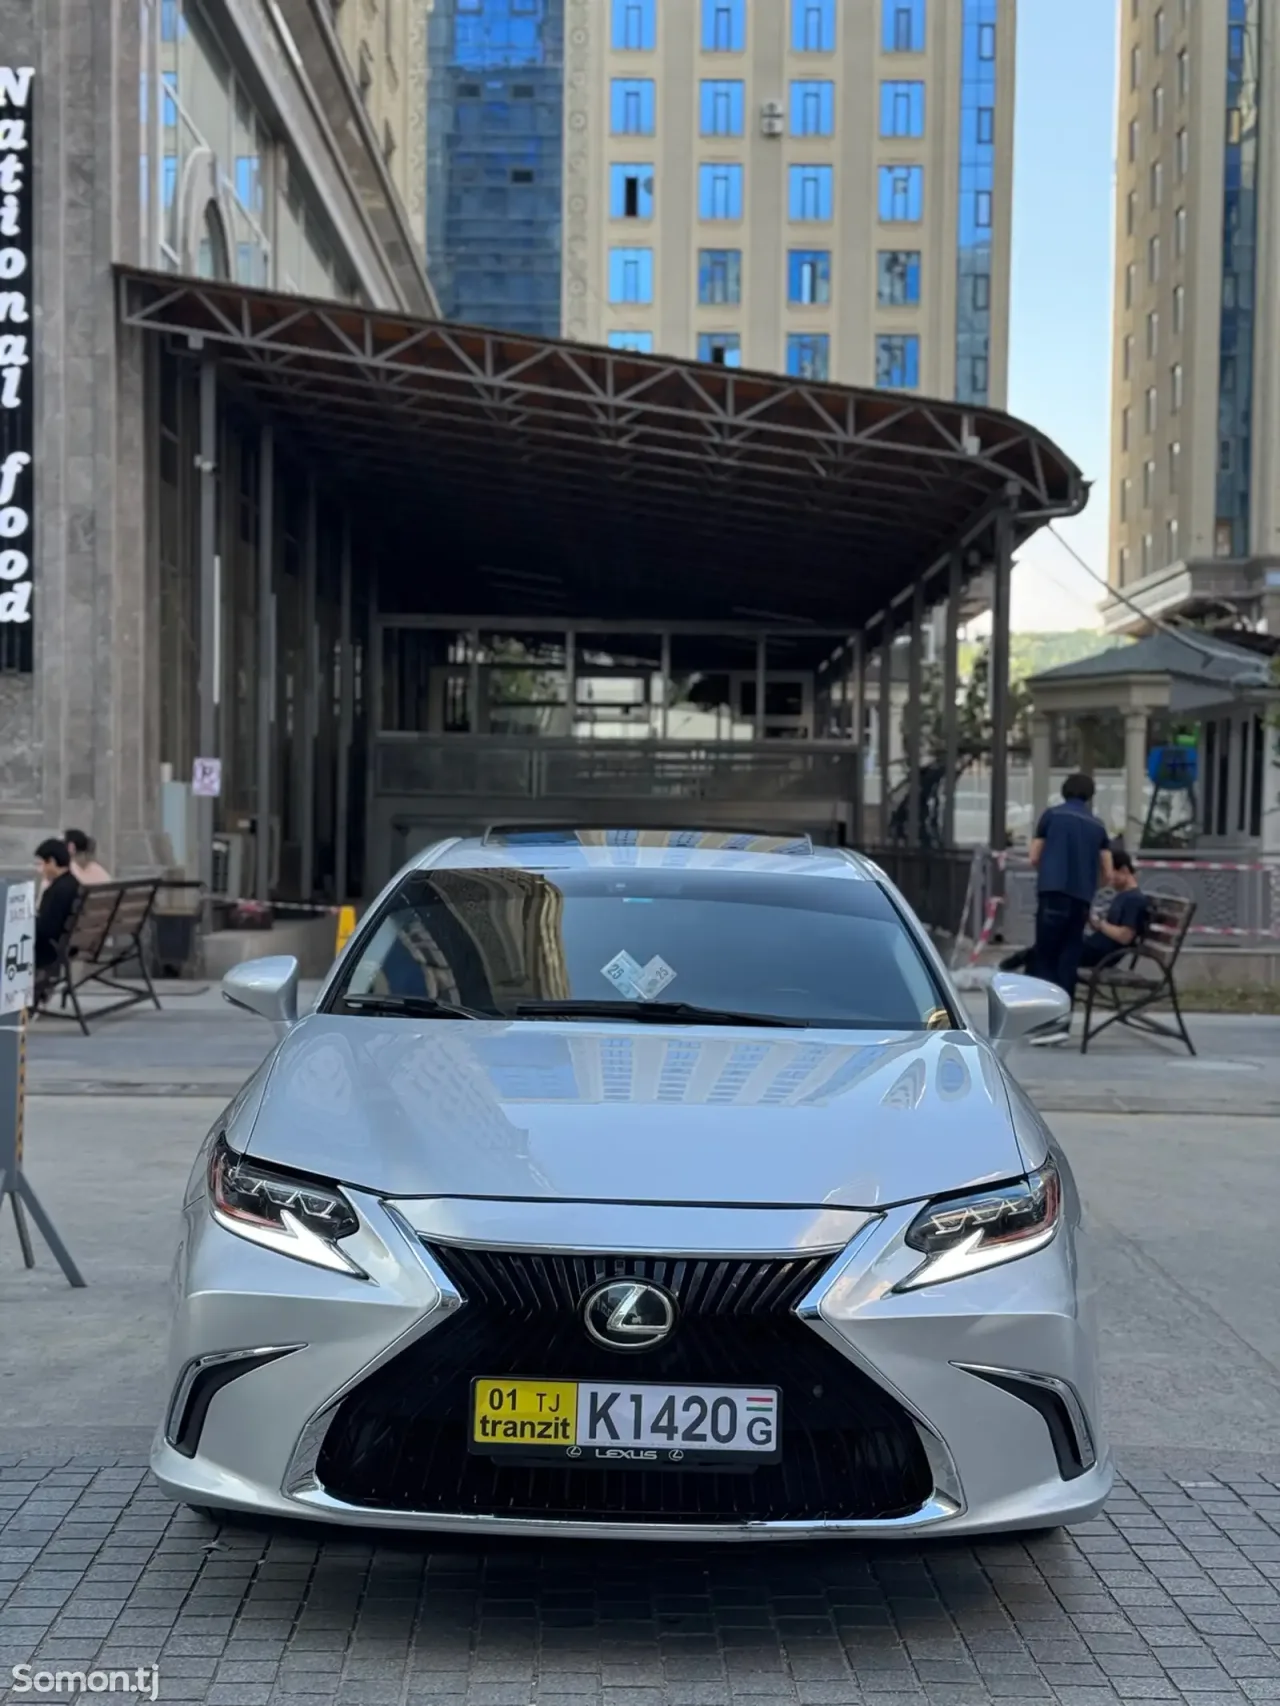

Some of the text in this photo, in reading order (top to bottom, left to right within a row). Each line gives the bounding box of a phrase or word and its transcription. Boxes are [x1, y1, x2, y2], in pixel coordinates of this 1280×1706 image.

[0, 66, 36, 623] National food
[488, 1387, 561, 1413] 01 TJ
[479, 1413, 571, 1440] tranzit
[588, 1391, 738, 1444] K1420
[746, 1417, 773, 1445] G
[595, 1448, 658, 1460] LEXUS
